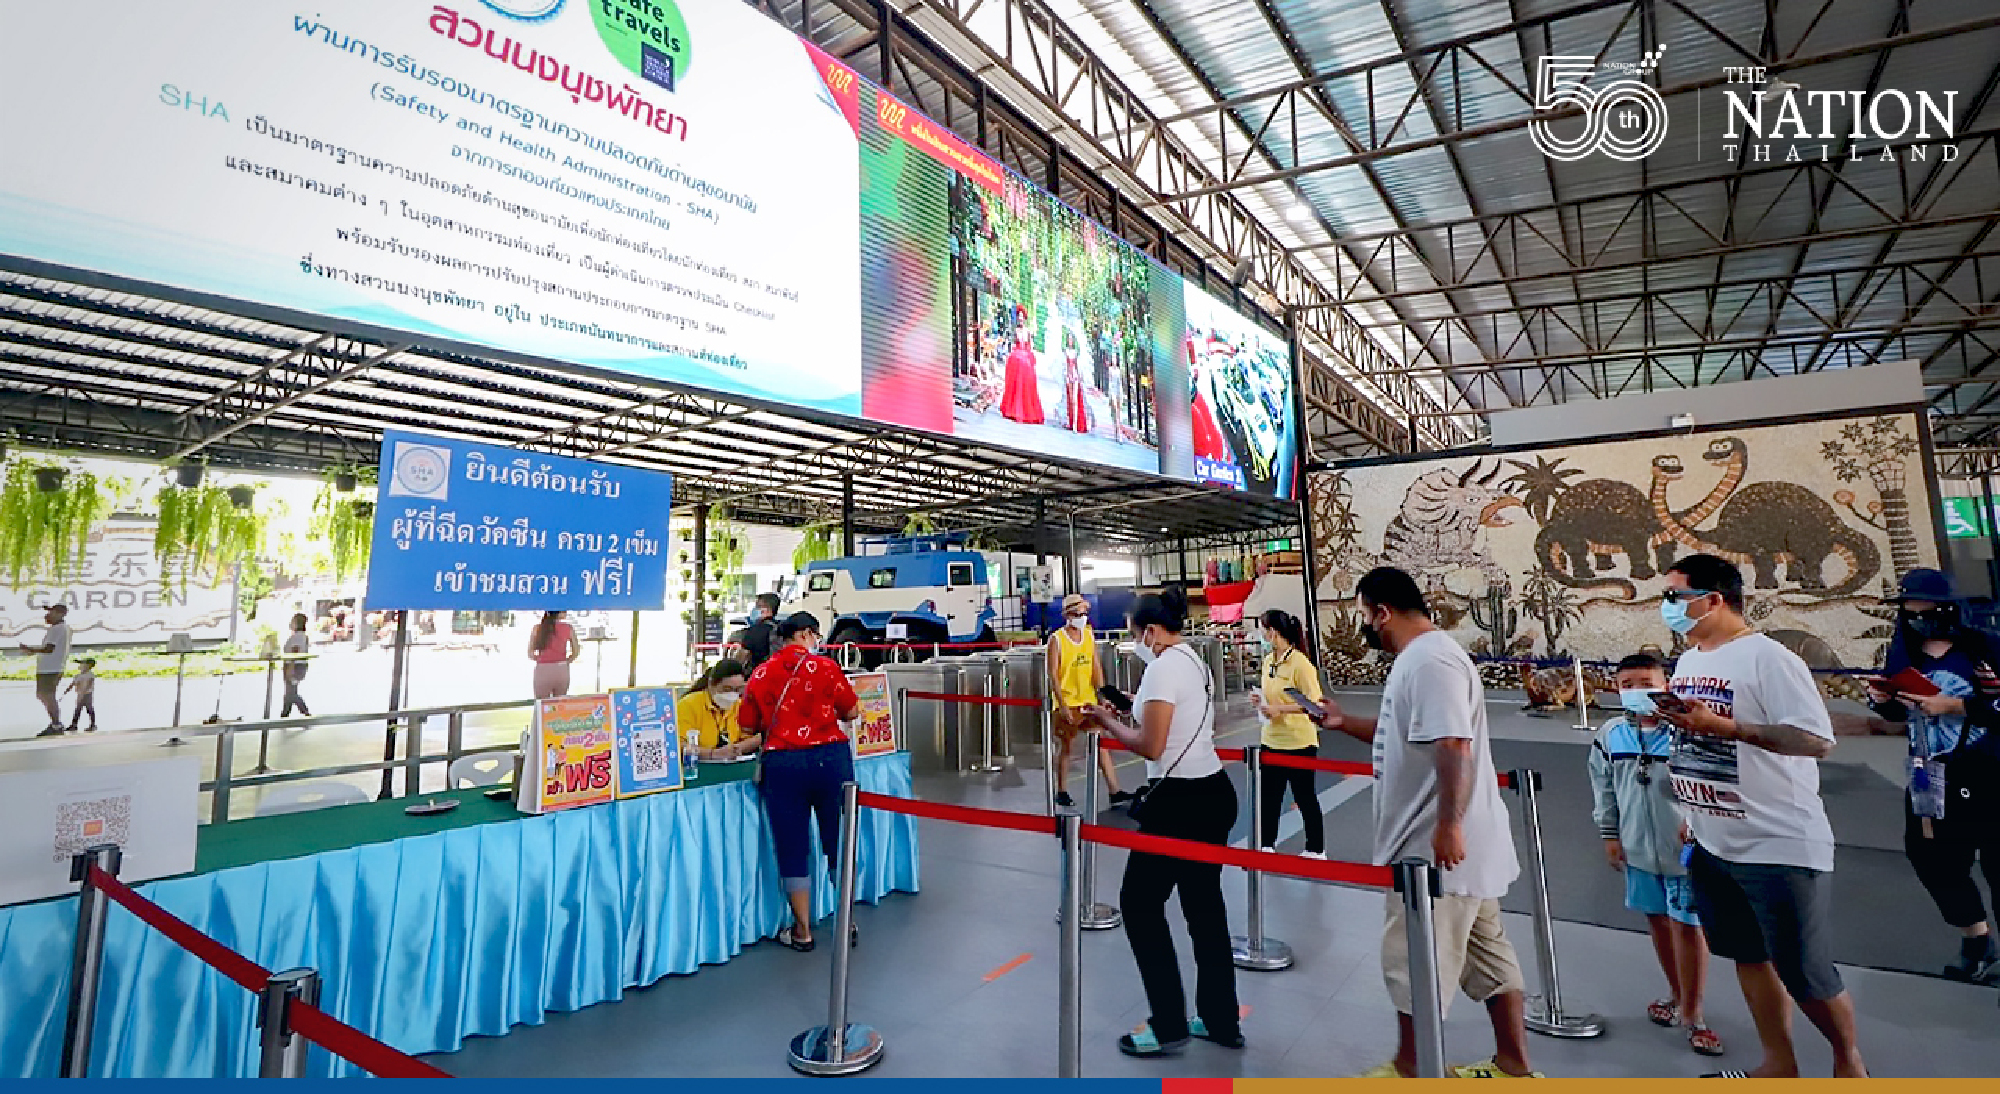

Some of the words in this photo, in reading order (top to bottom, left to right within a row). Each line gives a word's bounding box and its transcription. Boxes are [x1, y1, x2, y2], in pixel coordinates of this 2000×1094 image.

[601, 0, 681, 53] travels
[429, 5, 687, 142] สวนนงนุชพัทยา
[158, 83, 230, 123] SHA
[370, 82, 449, 124] (Safety
[456, 117, 493, 139] and
[499, 131, 556, 163] Health
[561, 155, 671, 206] Administration
[686, 201, 720, 225] SHA)
[466, 452, 621, 499] ยินดีต้อนรับ
[391, 505, 547, 550] ผู้ที่ฉีดวัคซีน
[557, 530, 603, 552] ครบ
[607, 533, 620, 554] 2
[624, 528, 659, 556] เข็ม
[26, 589, 188, 611] GARDEN
[433, 562, 568, 595] เข้าชมสวน
[580, 556, 634, 597] ฟรี!
[565, 749, 613, 793] ฟรี
